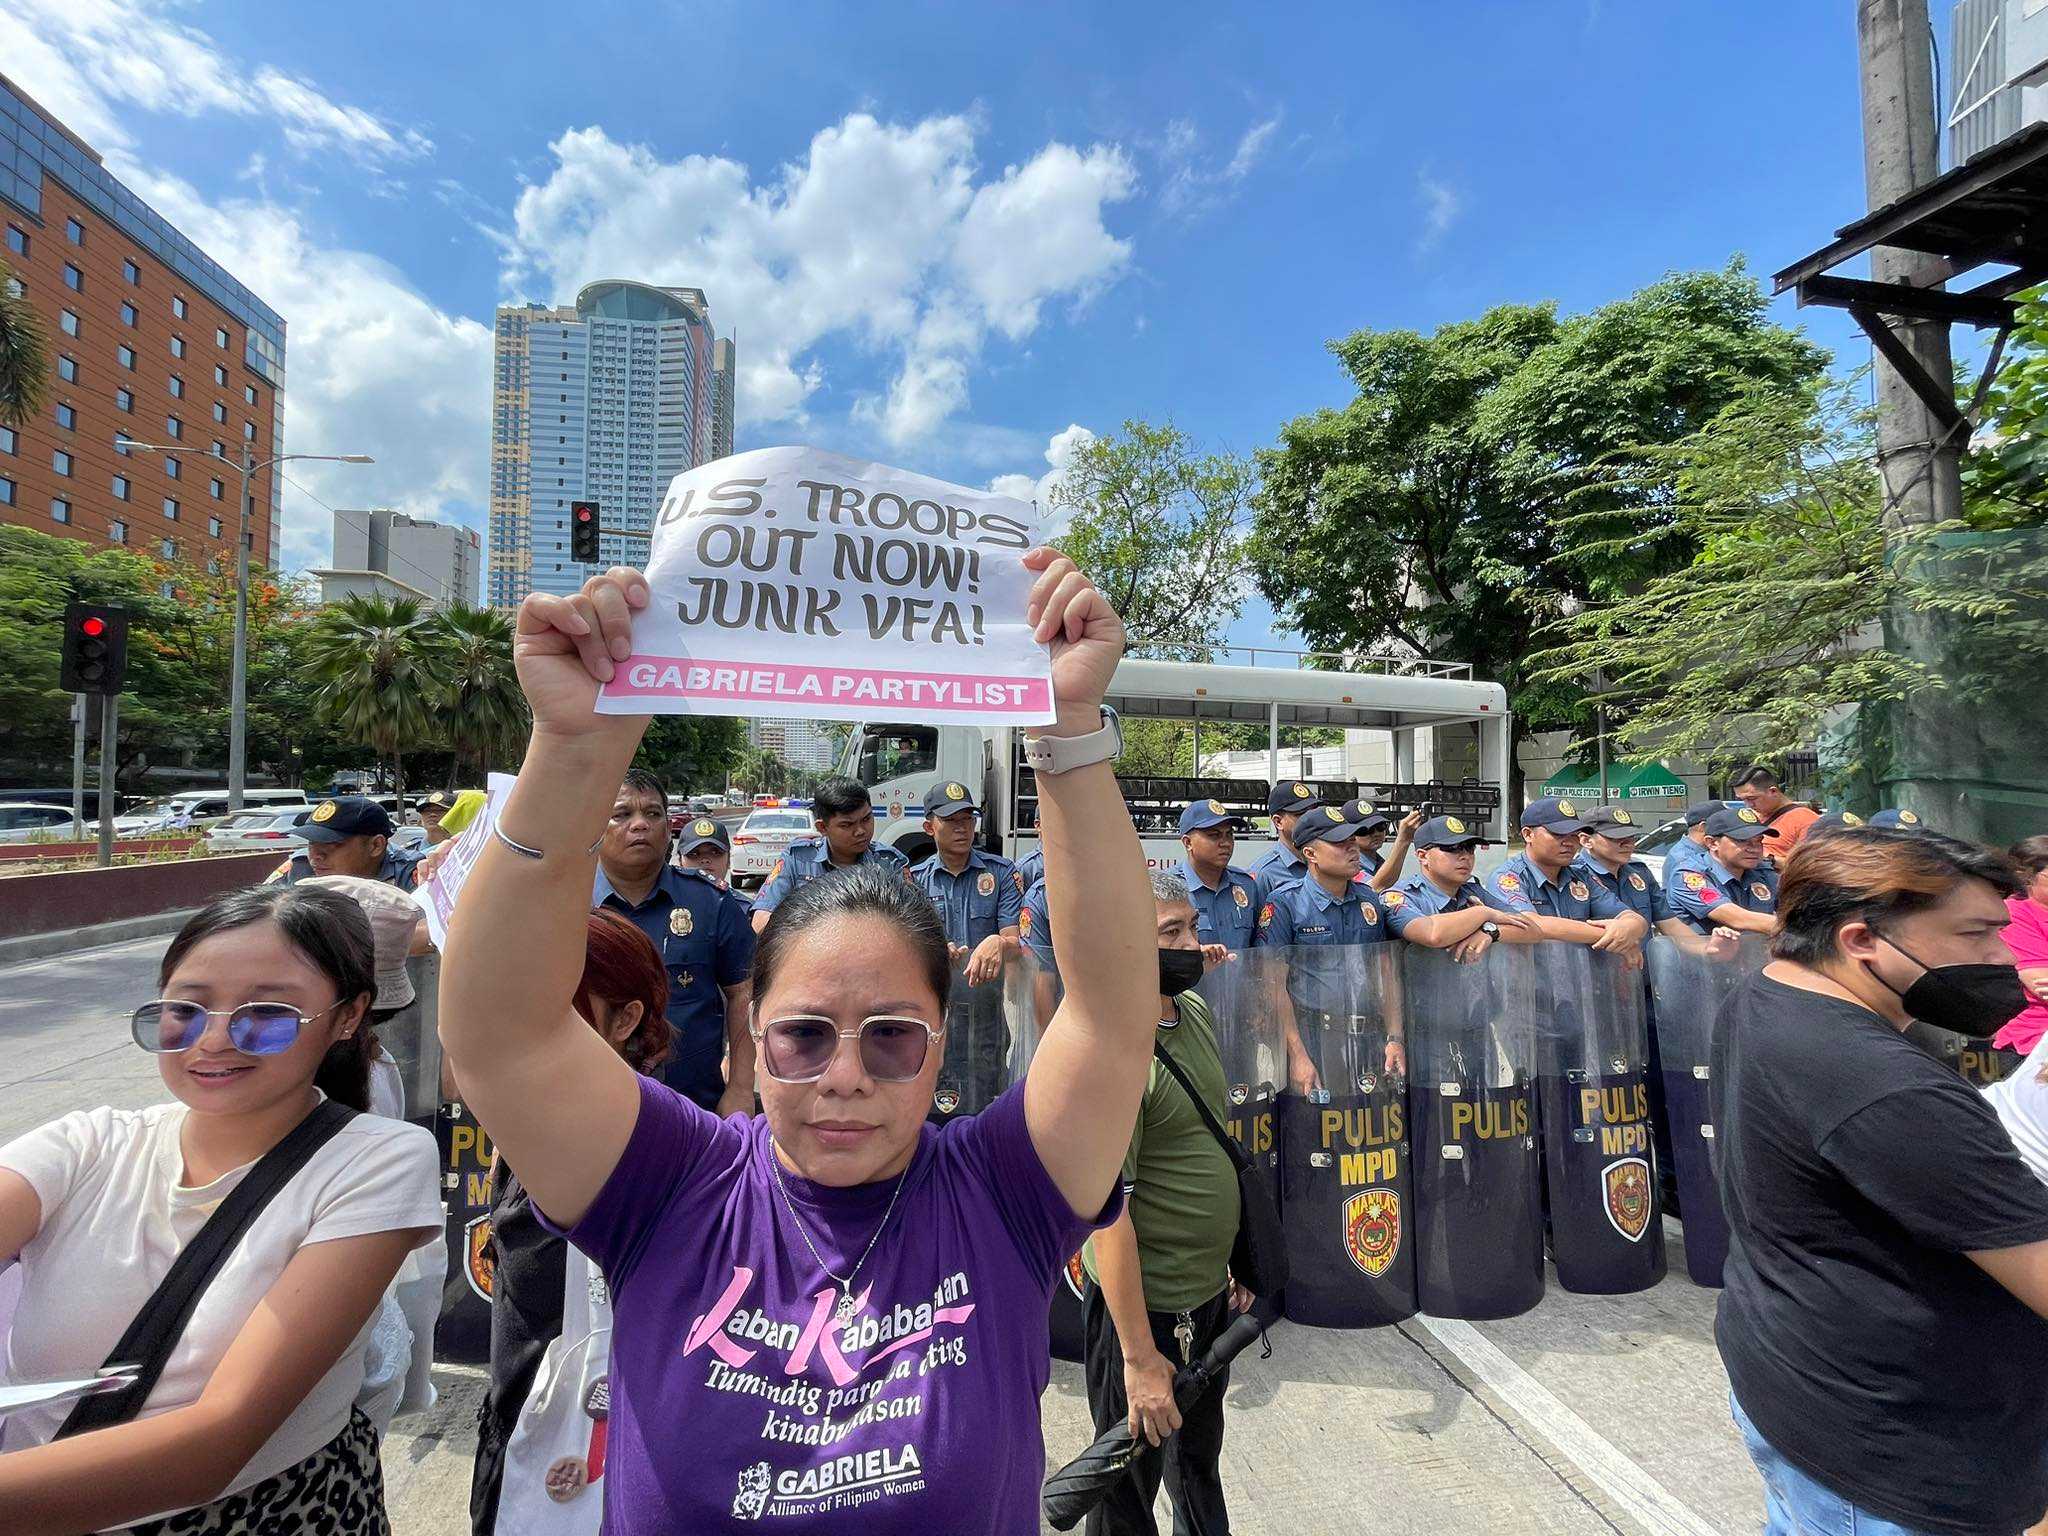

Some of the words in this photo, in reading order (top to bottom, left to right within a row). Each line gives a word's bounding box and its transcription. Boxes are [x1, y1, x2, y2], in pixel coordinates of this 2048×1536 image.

[660, 477, 777, 527] U.S.
[796, 480, 1030, 548] TROOPS
[696, 523, 818, 575] OUT
[833, 533, 980, 594] NOW!
[678, 577, 842, 637] JUNK
[861, 594, 985, 646] VFA!
[628, 664, 824, 697] GABRIELA
[831, 675, 1029, 706] PARTYLIST
[1638, 786, 1660, 797] IRWIN
[1663, 784, 1686, 795] TIENG
[1321, 1102, 1404, 1148] PULIS
[1452, 1098, 1529, 1141] PULIS
[1580, 1083, 1648, 1124] PULIS
[1602, 1124, 1647, 1155] MPD
[1340, 1148, 1398, 1186] MPD
[683, 1267, 801, 1369] Laban
[704, 1359, 822, 1416] Tumindig
[776, 1443, 921, 1495] GABRIELA
[767, 1501, 815, 1516] Alliance
[819, 1497, 832, 1513] of
[835, 1488, 880, 1508] Filipino
[883, 1479, 926, 1497] Women
